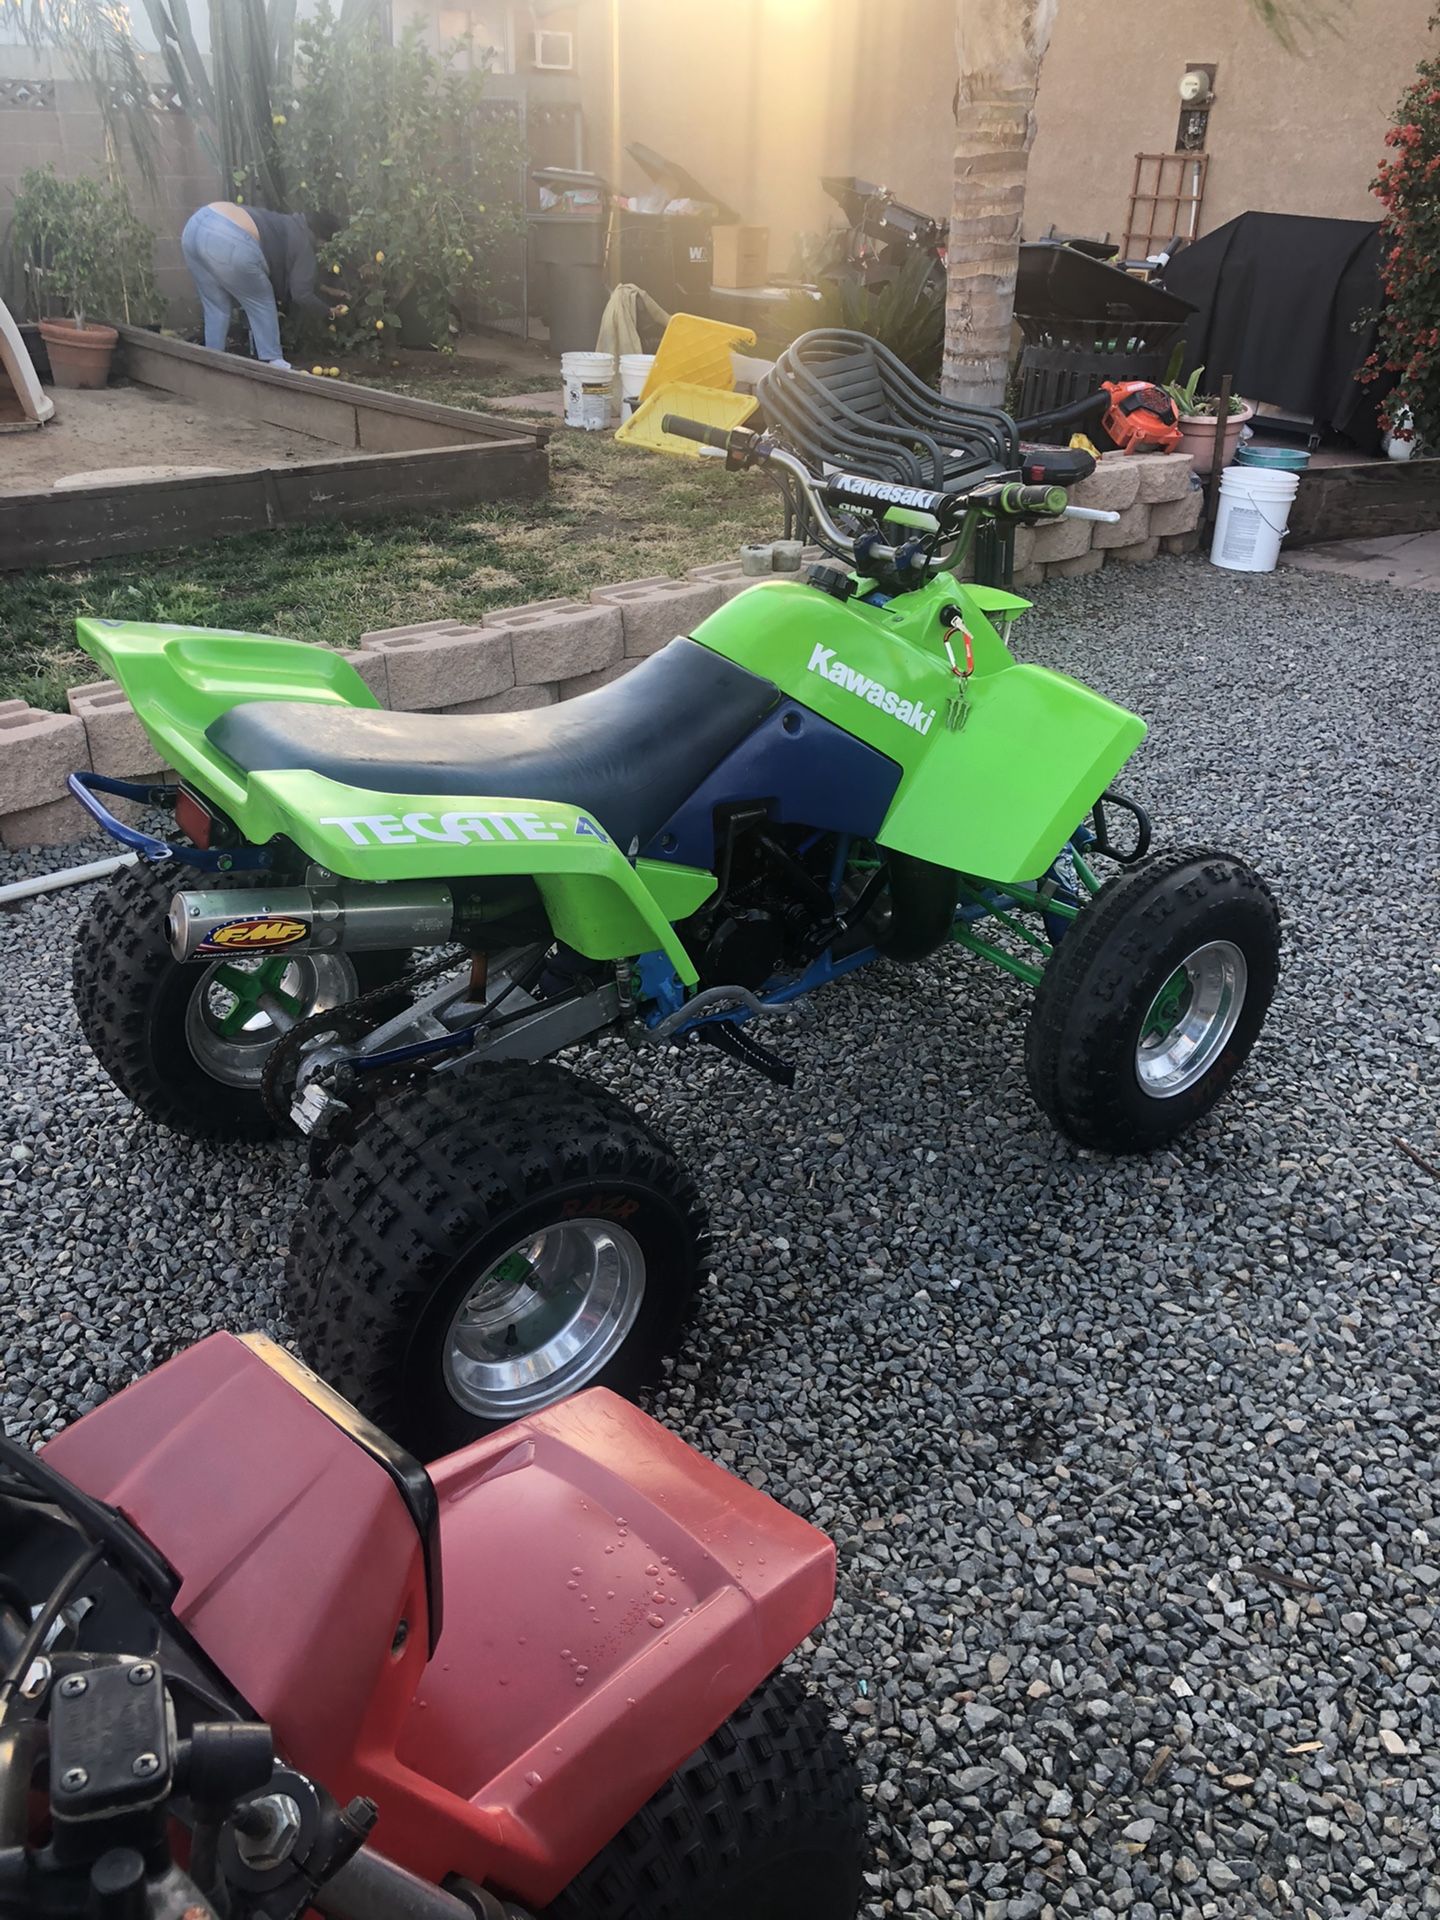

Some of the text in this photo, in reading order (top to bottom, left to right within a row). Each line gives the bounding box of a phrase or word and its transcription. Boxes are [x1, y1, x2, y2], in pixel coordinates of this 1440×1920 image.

[836, 477, 935, 509] Kawasaki
[807, 642, 937, 736] Kawasaki
[214, 922, 306, 943] FMF
